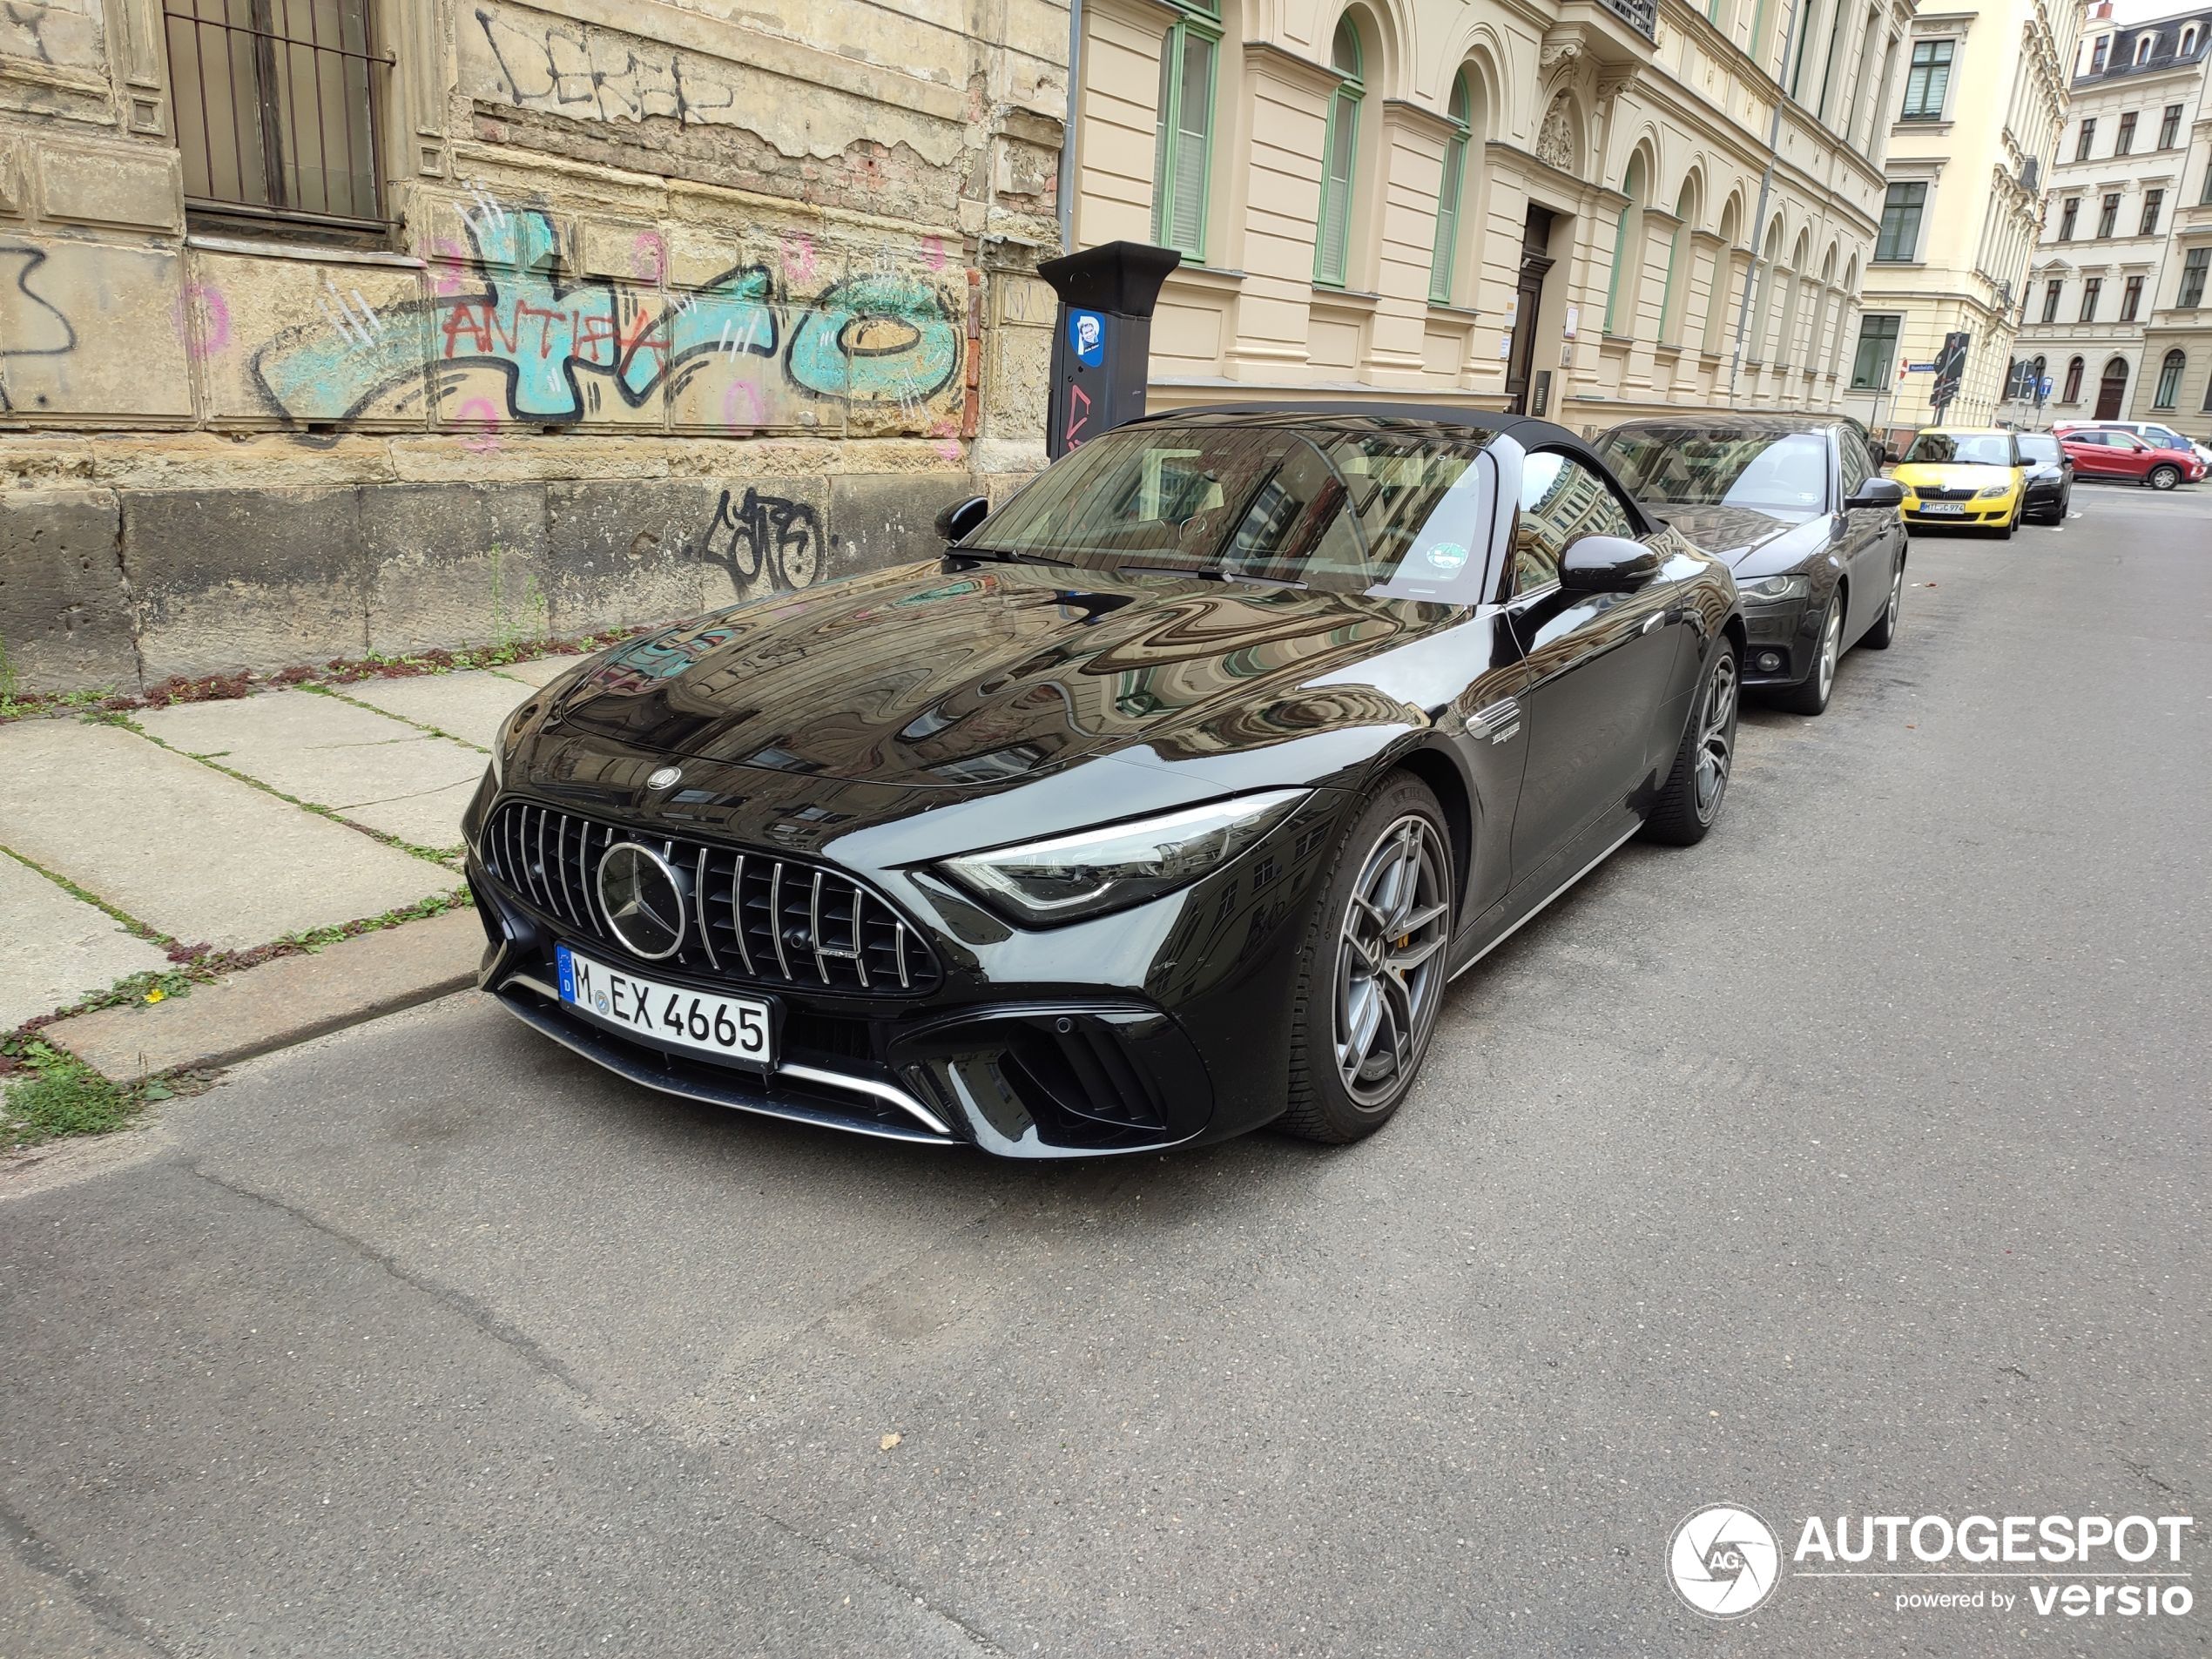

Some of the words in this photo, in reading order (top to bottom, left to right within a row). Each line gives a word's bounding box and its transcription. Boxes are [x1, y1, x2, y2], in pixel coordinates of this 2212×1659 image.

[442, 299, 671, 378] ANTIFA
[564, 979, 571, 992] D
[573, 958, 592, 1005] M
[610, 974, 653, 1029] EX
[664, 993, 764, 1053] 4665
